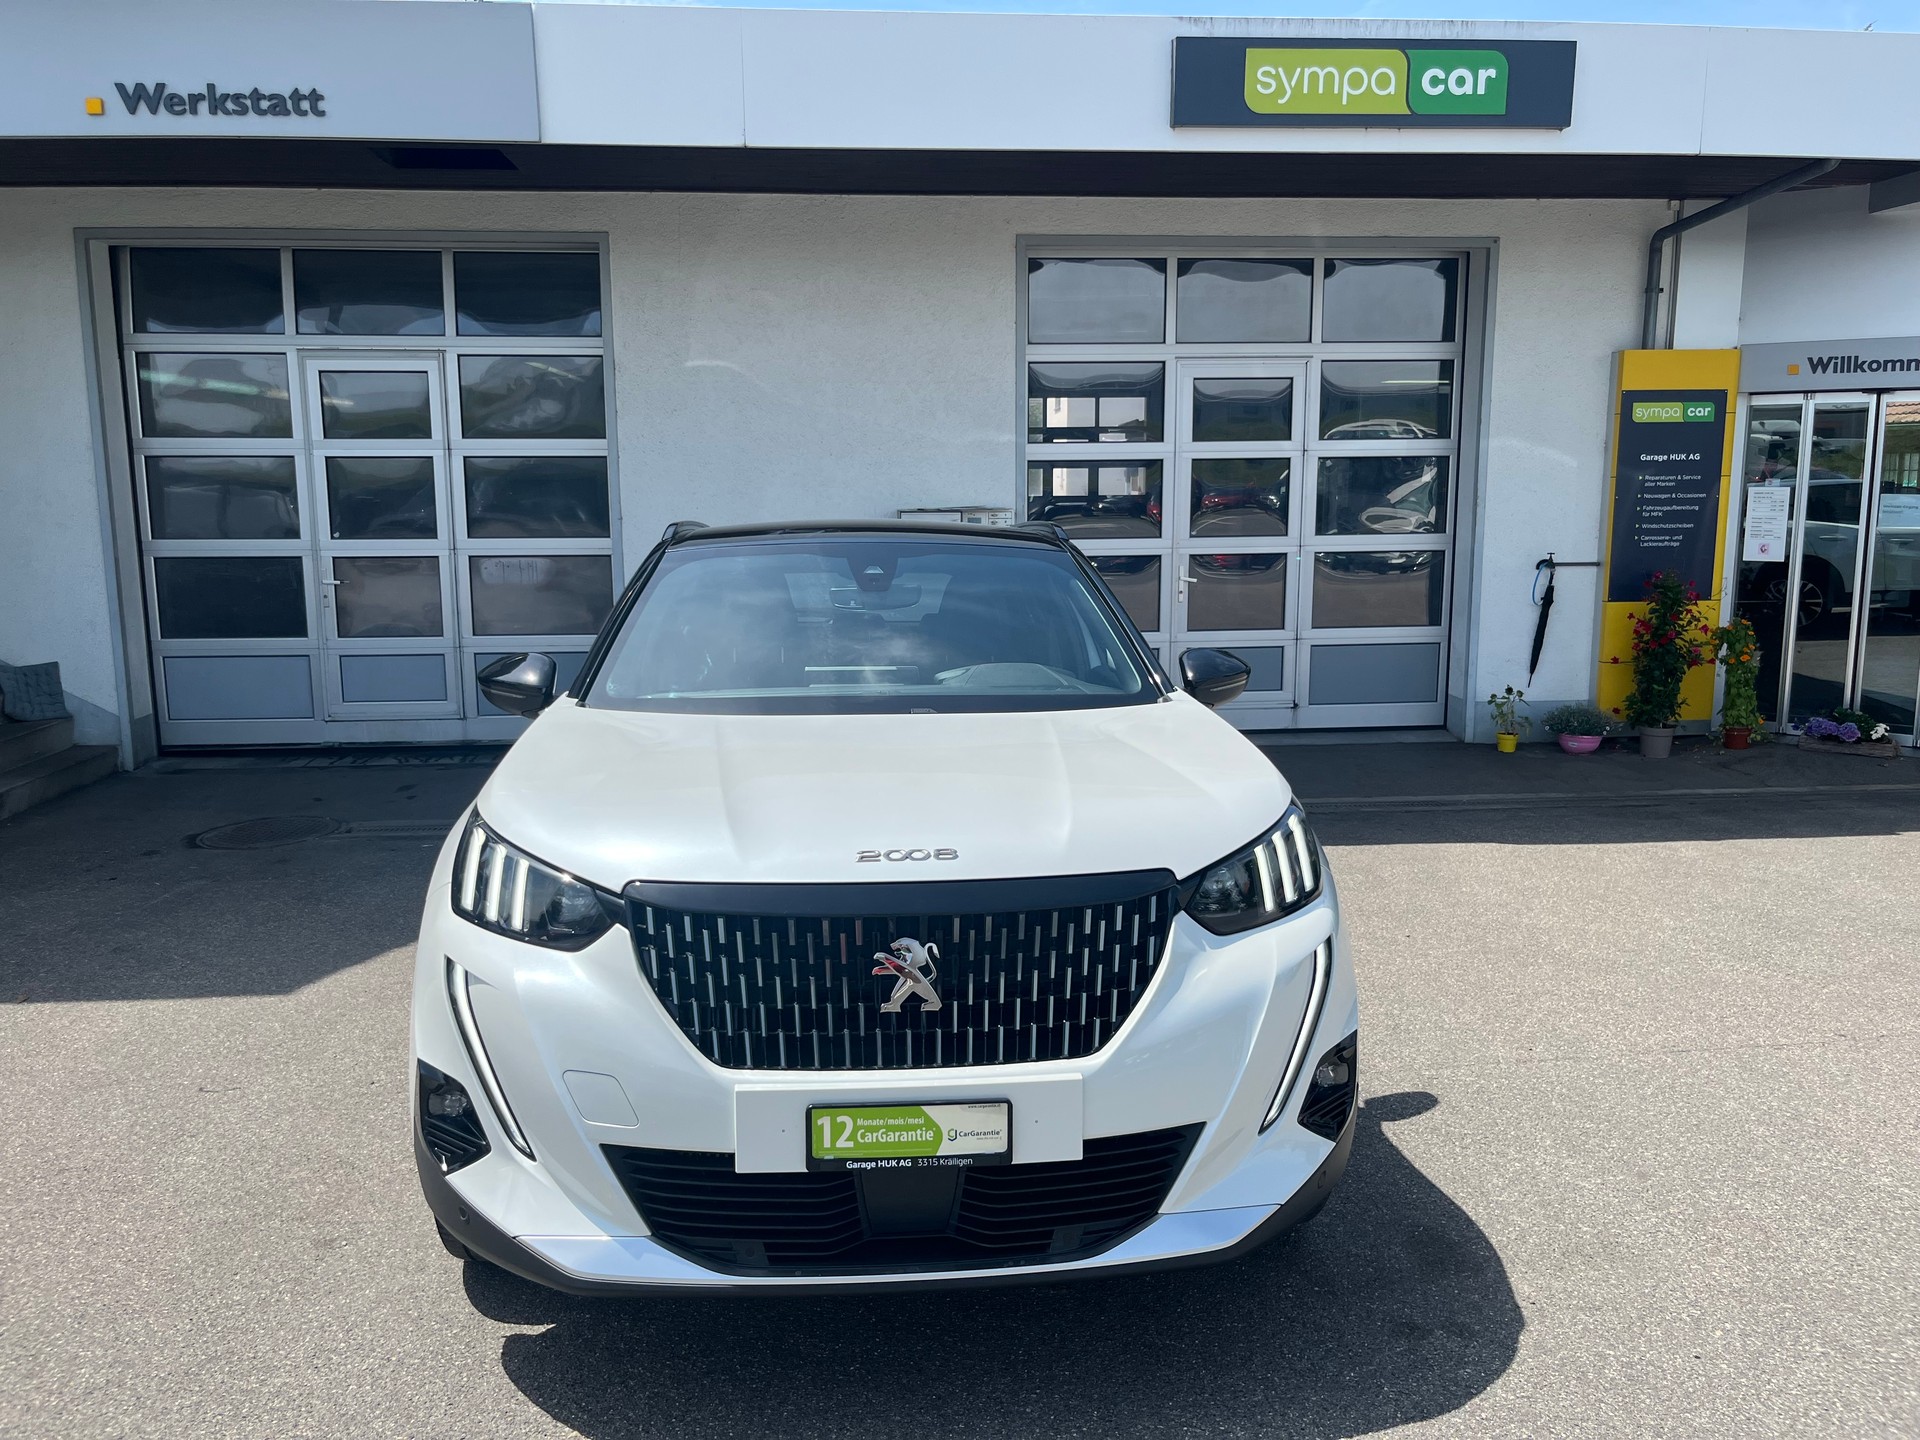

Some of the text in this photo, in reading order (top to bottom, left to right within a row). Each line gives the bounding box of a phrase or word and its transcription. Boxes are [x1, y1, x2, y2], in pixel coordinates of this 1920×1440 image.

[1256, 66, 1496, 105] sympa car
[114, 82, 326, 117] Werkstatt
[1635, 407, 1711, 420] sympa car
[1640, 453, 1701, 462] Garage HUK AG
[855, 848, 959, 862] 2008
[857, 1116, 925, 1126] Monate/mois/mesi
[817, 1115, 854, 1148] 12
[857, 1127, 934, 1143] CarGarantie
[846, 1160, 876, 1170] Garage
[878, 1159, 898, 1168] HUK
[898, 1158, 912, 1167] AG
[917, 1158, 939, 1167] 3315
